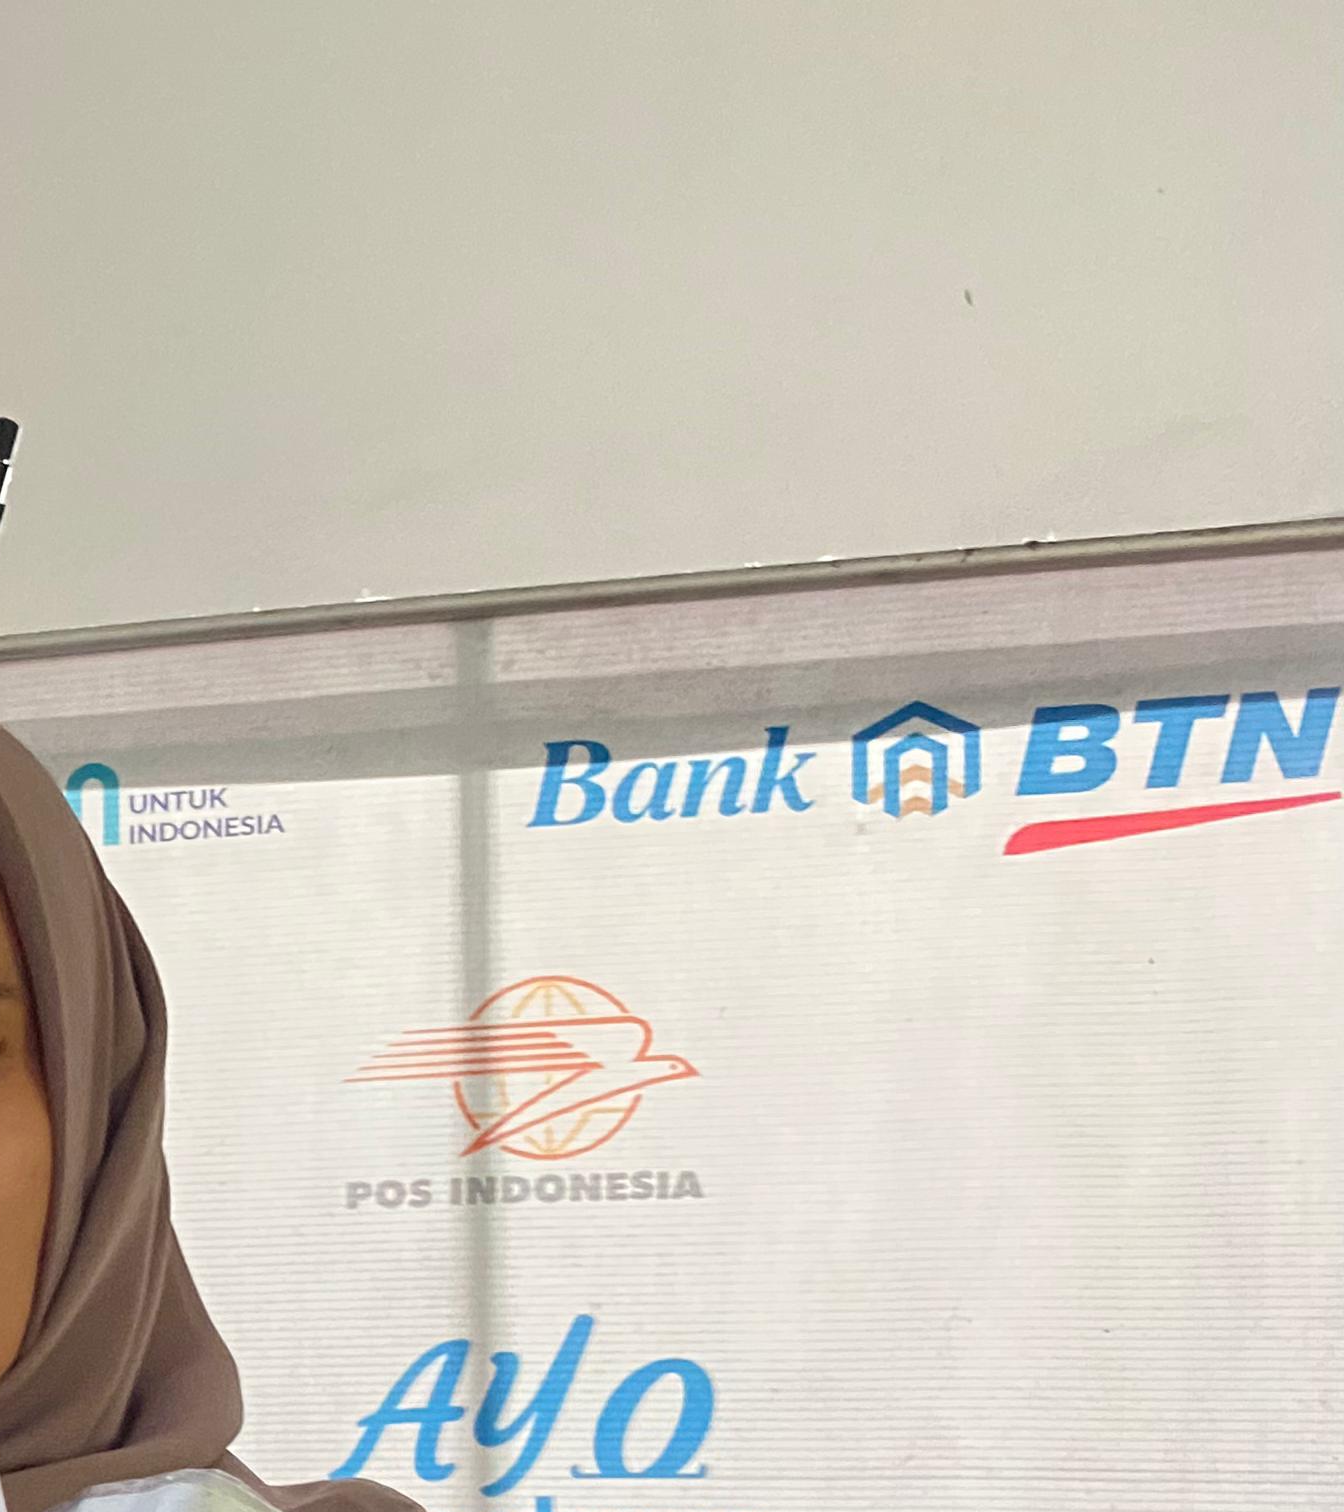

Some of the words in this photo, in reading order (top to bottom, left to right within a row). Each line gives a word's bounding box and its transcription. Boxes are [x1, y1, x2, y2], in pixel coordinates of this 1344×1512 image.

[525, 725, 818, 829] Bank
[1014, 686, 1343, 797] BTN
[129, 788, 230, 815] UNTUK
[129, 813, 286, 846] INDONESIA
[345, 1178, 433, 1210] POS
[449, 1169, 705, 1206] INDONESIA
